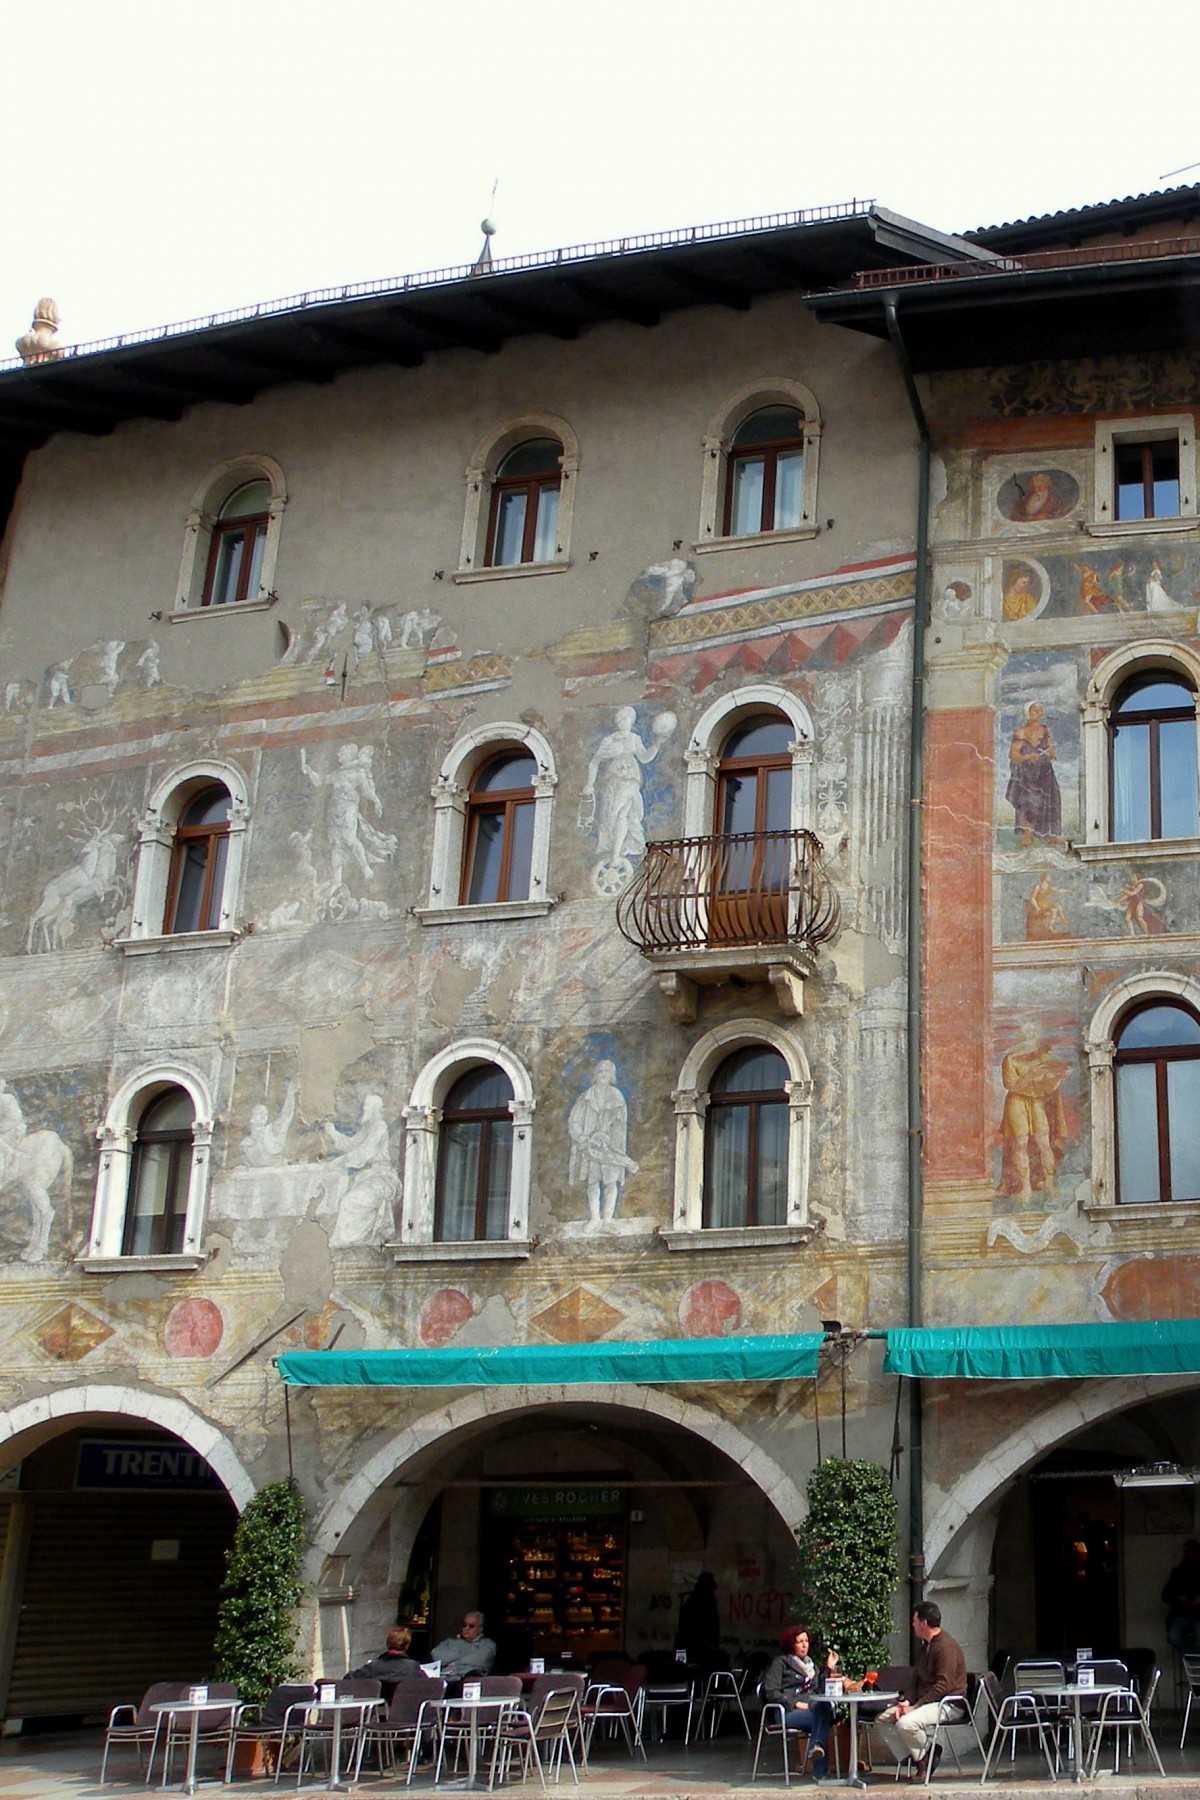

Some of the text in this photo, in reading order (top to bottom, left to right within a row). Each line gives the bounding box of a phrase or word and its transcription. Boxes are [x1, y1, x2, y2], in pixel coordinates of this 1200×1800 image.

[102, 1449, 211, 1478] TRENTI
[554, 1489, 621, 1504] ROCHER
[727, 1590, 753, 1621] NO
